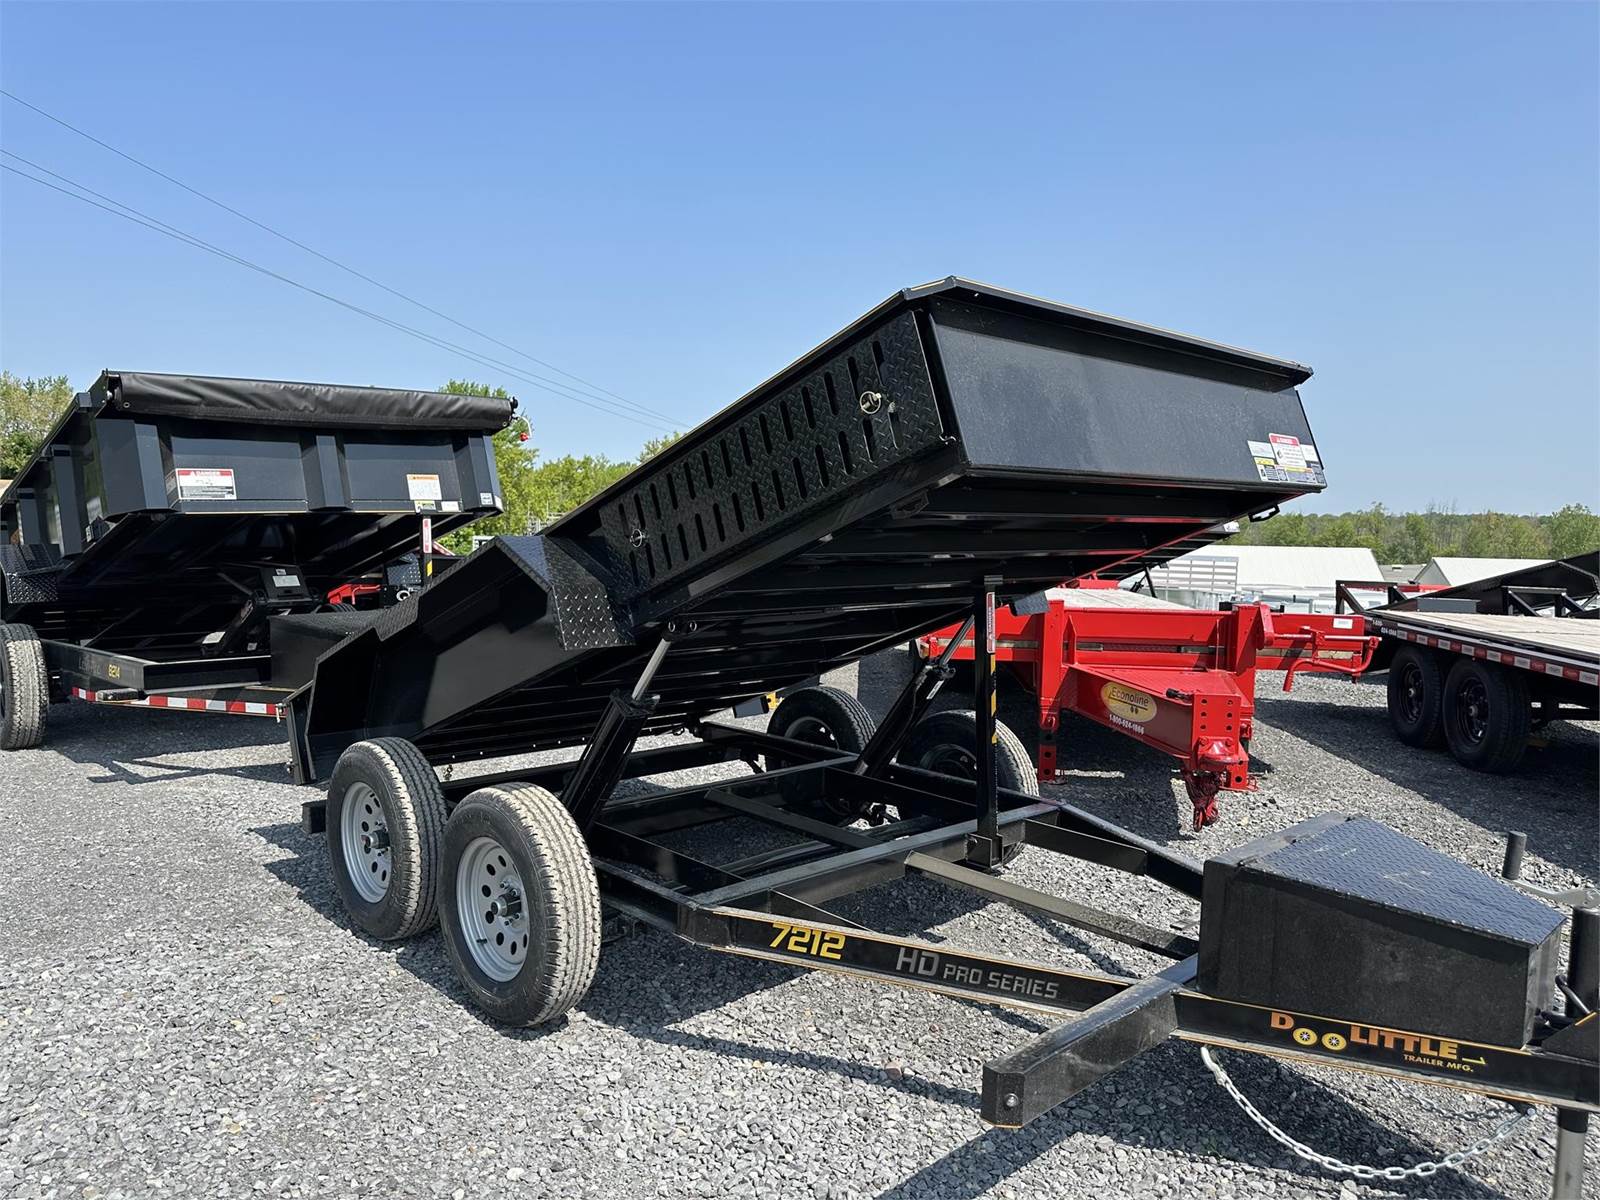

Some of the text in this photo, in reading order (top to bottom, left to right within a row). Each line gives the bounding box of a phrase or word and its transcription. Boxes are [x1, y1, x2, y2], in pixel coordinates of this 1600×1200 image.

[1110, 686, 1150, 707] Econoline
[769, 922, 846, 960] 7212
[896, 947, 1060, 999] HD PRO SERIES
[1403, 1053, 1475, 1073] TRAILER MFG.
